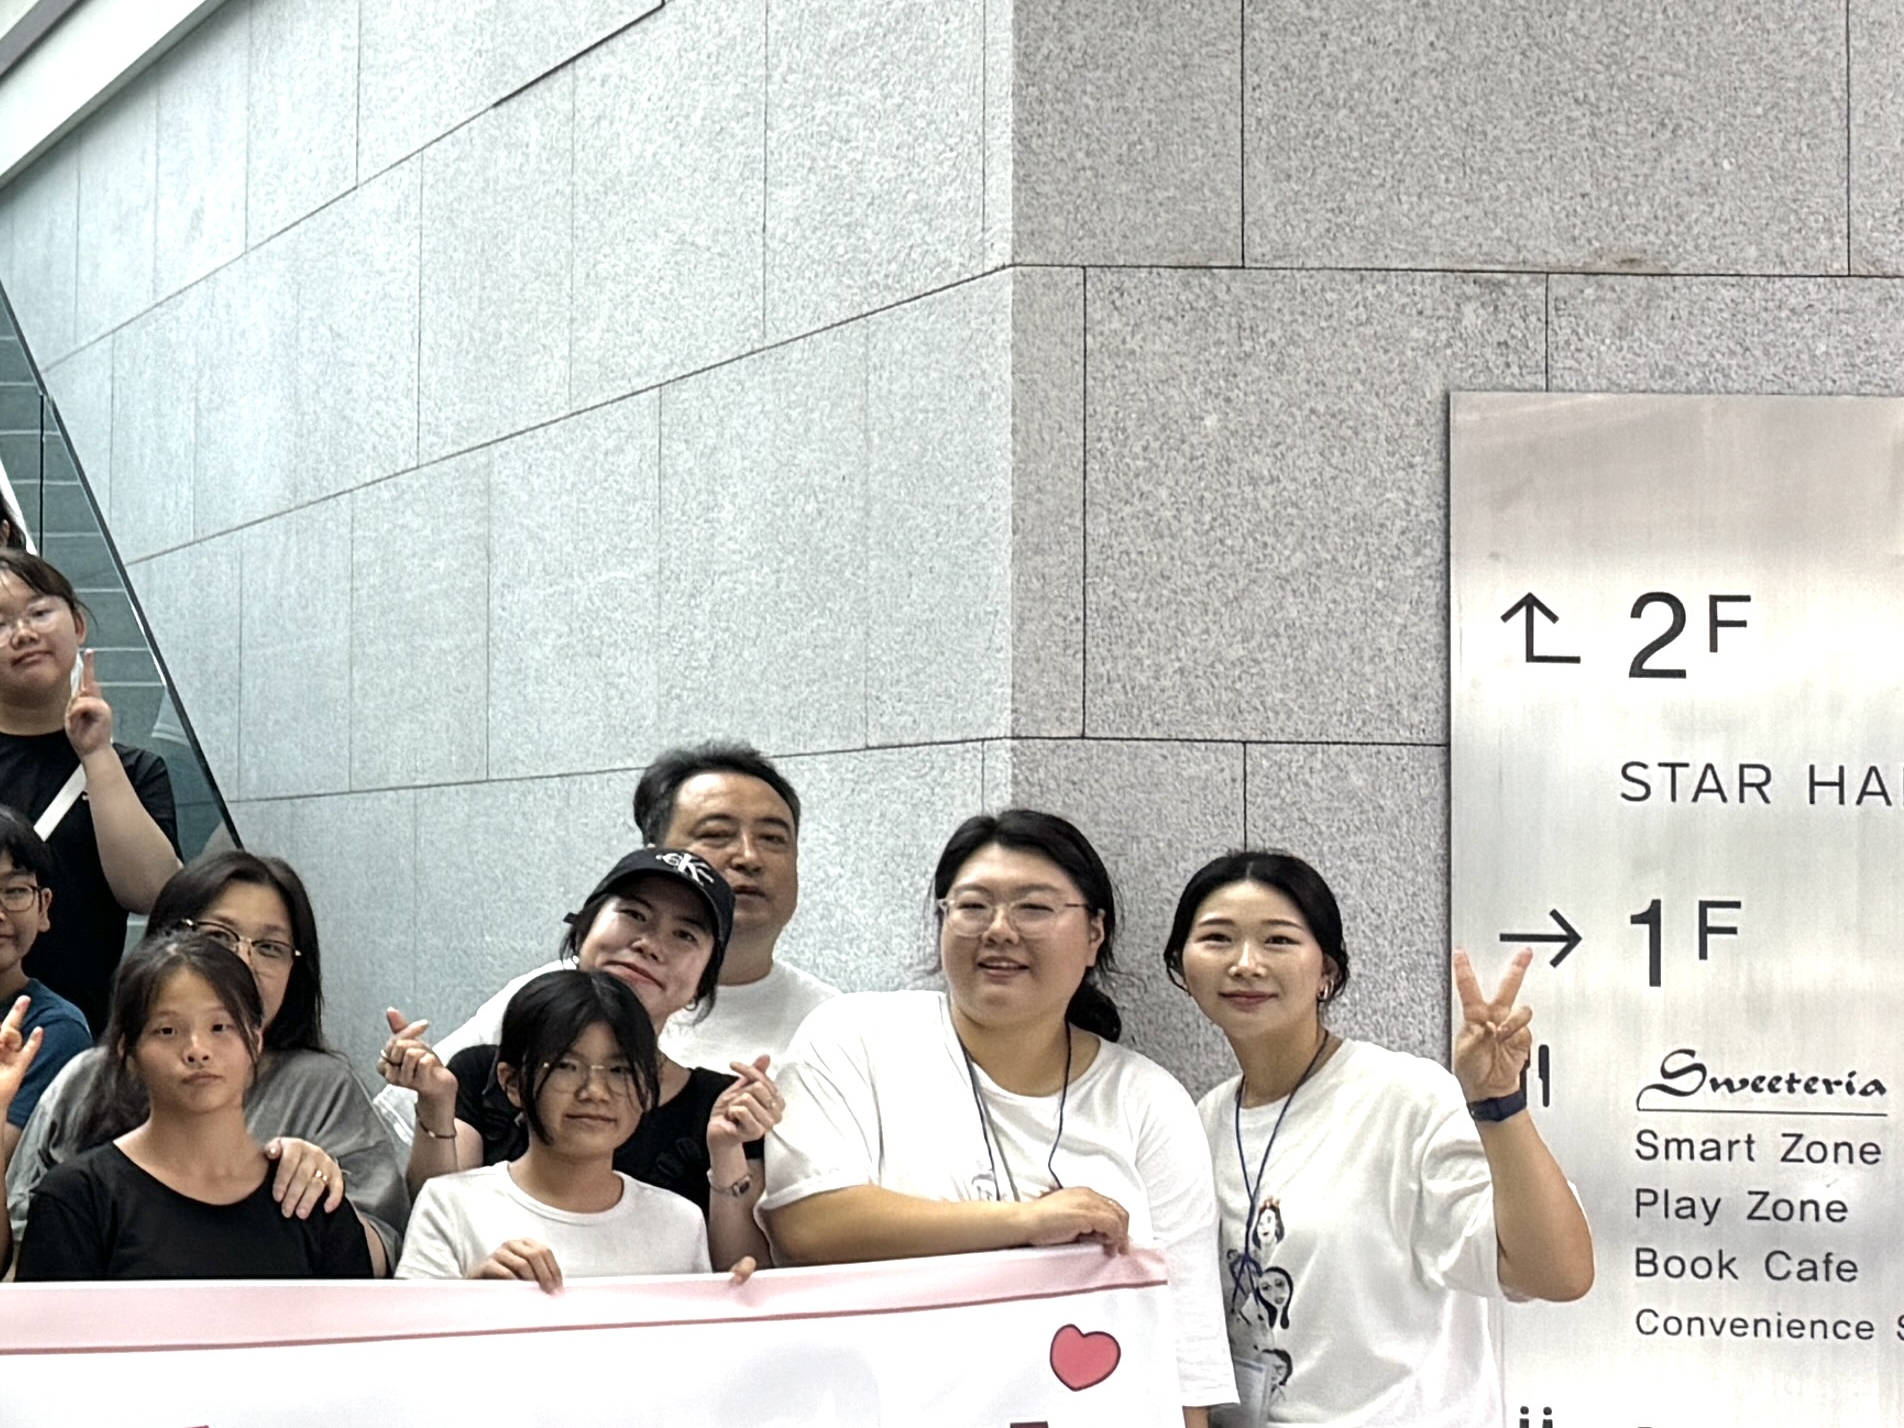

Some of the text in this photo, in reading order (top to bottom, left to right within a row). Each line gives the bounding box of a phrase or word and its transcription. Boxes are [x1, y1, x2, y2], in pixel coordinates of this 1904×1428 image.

[1628, 590, 1752, 679] 2F
[1620, 760, 1904, 807] STAR HA
[1629, 898, 1742, 988] 1F
[1635, 1048, 1888, 1114] Sweeteria
[1635, 1128, 1882, 1165] Smart Zone
[1635, 1187, 1848, 1226] Play Zone
[1635, 1246, 1859, 1282] Book Cafe
[1635, 1307, 1875, 1341] Convenience
